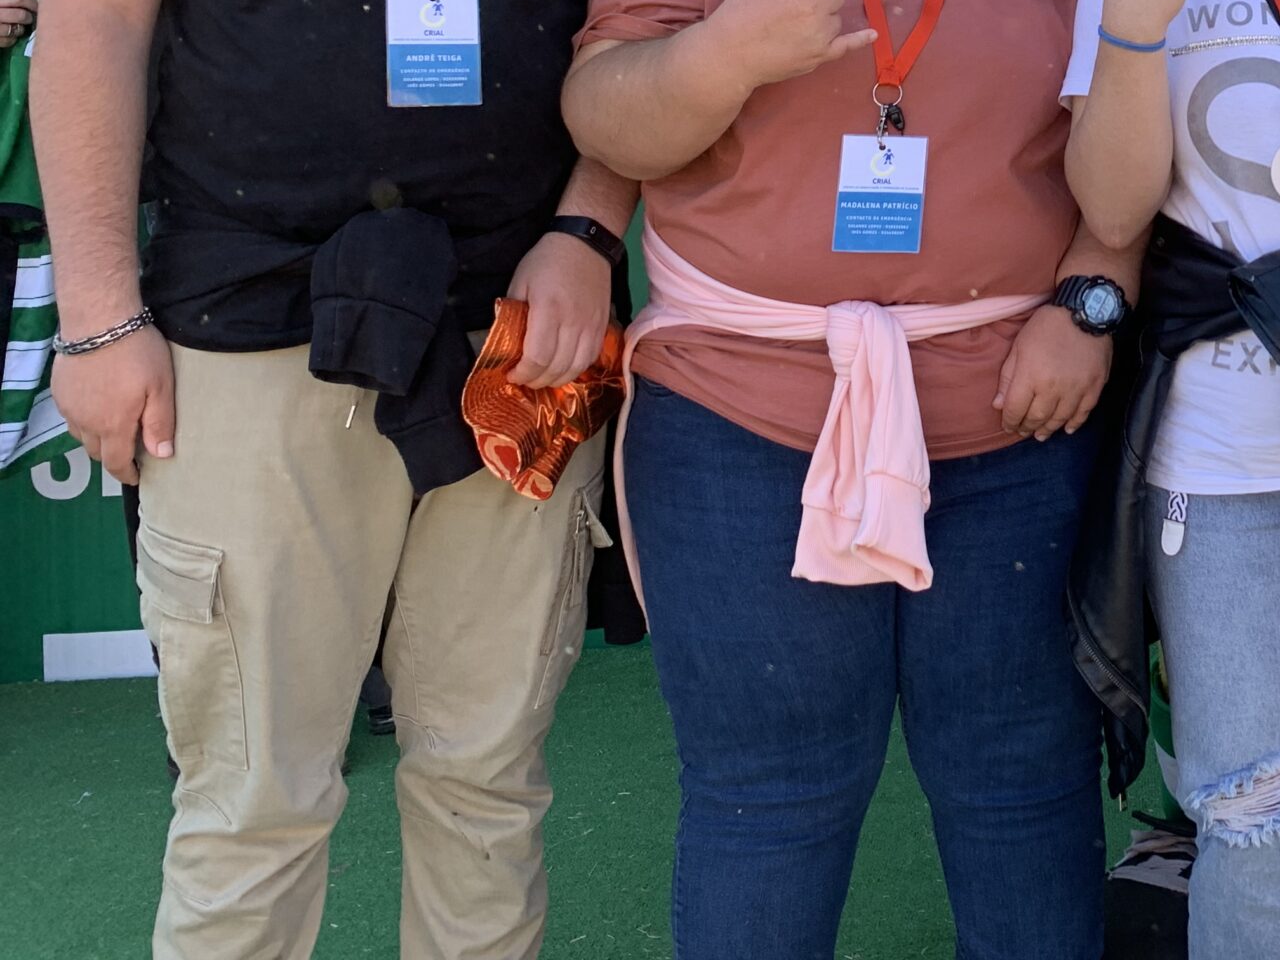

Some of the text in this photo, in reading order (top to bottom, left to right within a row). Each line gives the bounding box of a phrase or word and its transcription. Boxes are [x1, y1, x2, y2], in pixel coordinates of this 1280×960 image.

[406, 53, 462, 62] ANDRÉ TEIGA
[840, 201, 919, 210] MADALENA PATRÍCIO
